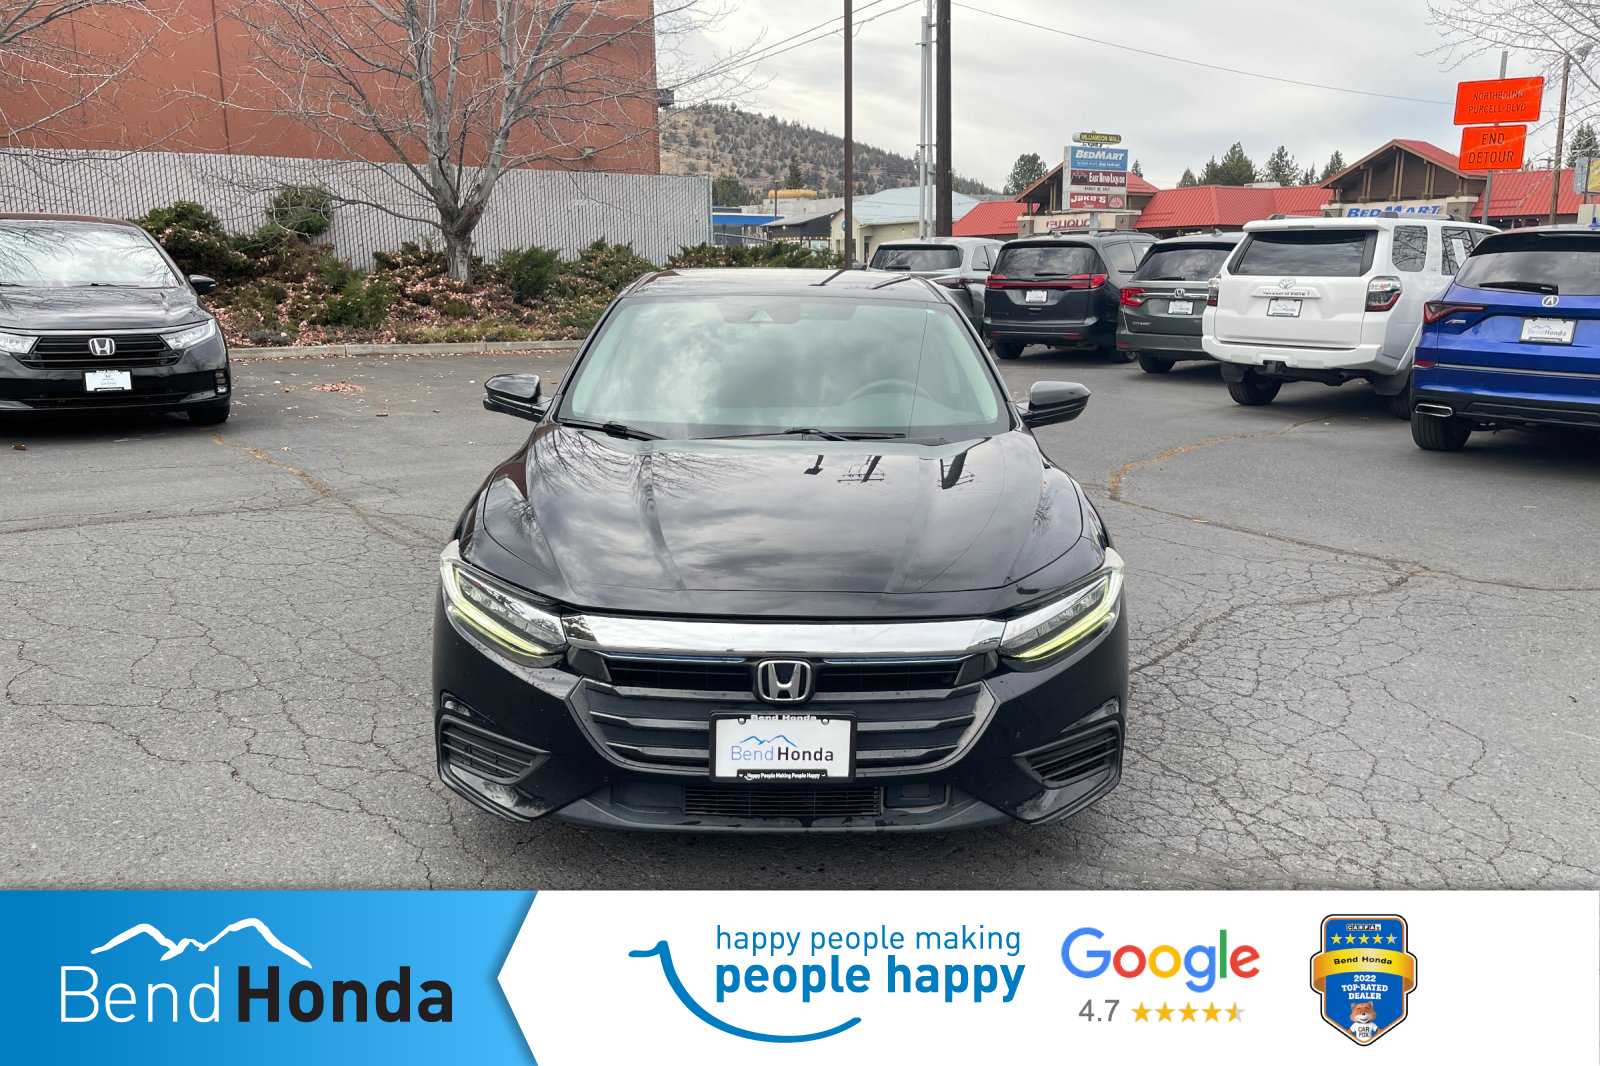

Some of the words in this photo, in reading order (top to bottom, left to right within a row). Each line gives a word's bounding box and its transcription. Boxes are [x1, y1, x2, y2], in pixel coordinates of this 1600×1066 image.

[1468, 103, 1502, 114] PURCELL
[1505, 103, 1526, 113] BLVD
[1481, 132, 1505, 145] END
[1468, 150, 1514, 164] DETOUR
[731, 745, 774, 761] Bend
[777, 746, 834, 761] Honda
